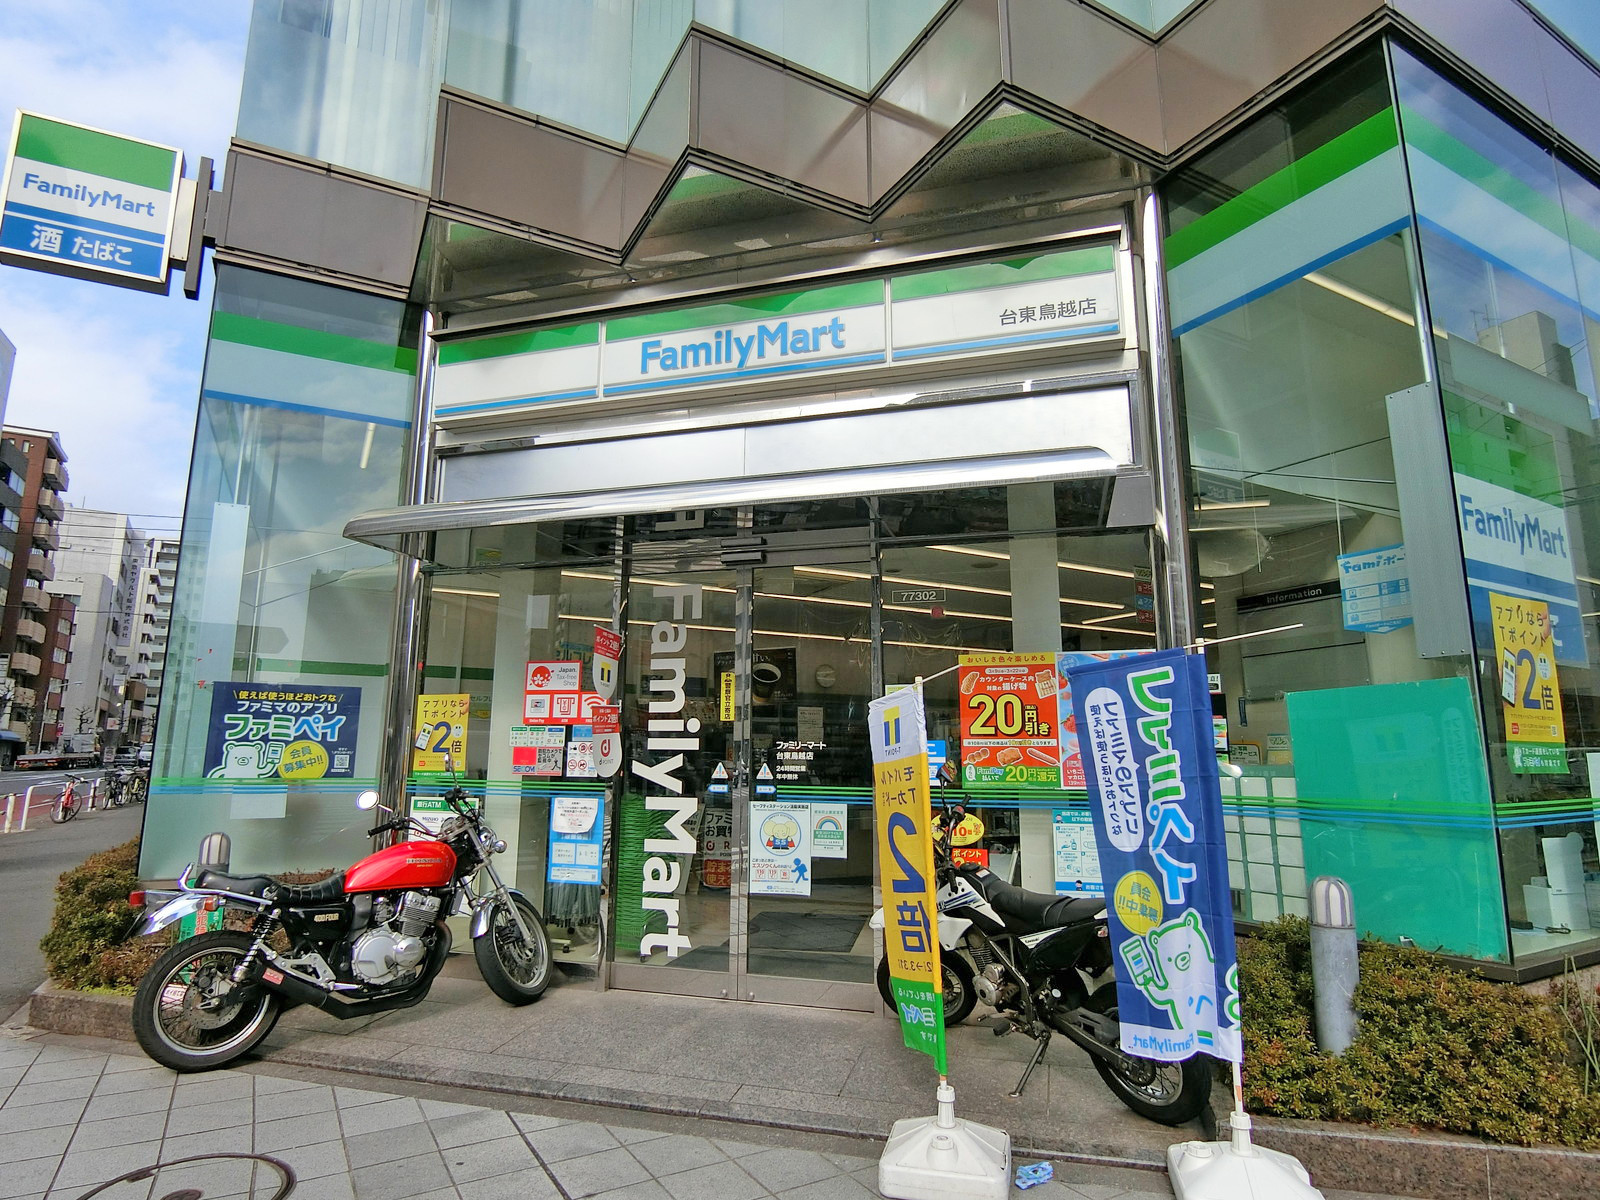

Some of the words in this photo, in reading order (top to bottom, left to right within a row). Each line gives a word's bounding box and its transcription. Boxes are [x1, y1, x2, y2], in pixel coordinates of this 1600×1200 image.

[23, 172, 155, 217] FamilyMart
[30, 224, 64, 254] 酒
[71, 236, 133, 266] たばこ
[999, 298, 1097, 326] 台東鳥越店
[641, 316, 845, 373] FamilyMart
[1460, 494, 1566, 558] FamilyMart
[901, 590, 937, 601] 77302
[1267, 587, 1323, 603] Information
[1496, 605, 1544, 627] アプリなら
[1499, 625, 1546, 647] Tポイント
[967, 655, 1046, 663] おいしさ色々楽しめる
[980, 675, 1034, 683] カウンターケース内
[239, 690, 337, 702] 使えば使うほどおトクな
[237, 701, 338, 714] ファミマのアプリ
[423, 700, 465, 708] アプリなら
[423, 710, 465, 719] Tポイント
[969, 693, 1023, 735] 20
[224, 714, 346, 741] ファミペイ
[290, 745, 313, 759] 会員
[776, 740, 827, 750] ファミリーマート
[776, 751, 814, 760] 台東鳥越店
[632, 584, 702, 958] FamilyMart
[953, 849, 982, 857] ポイント
